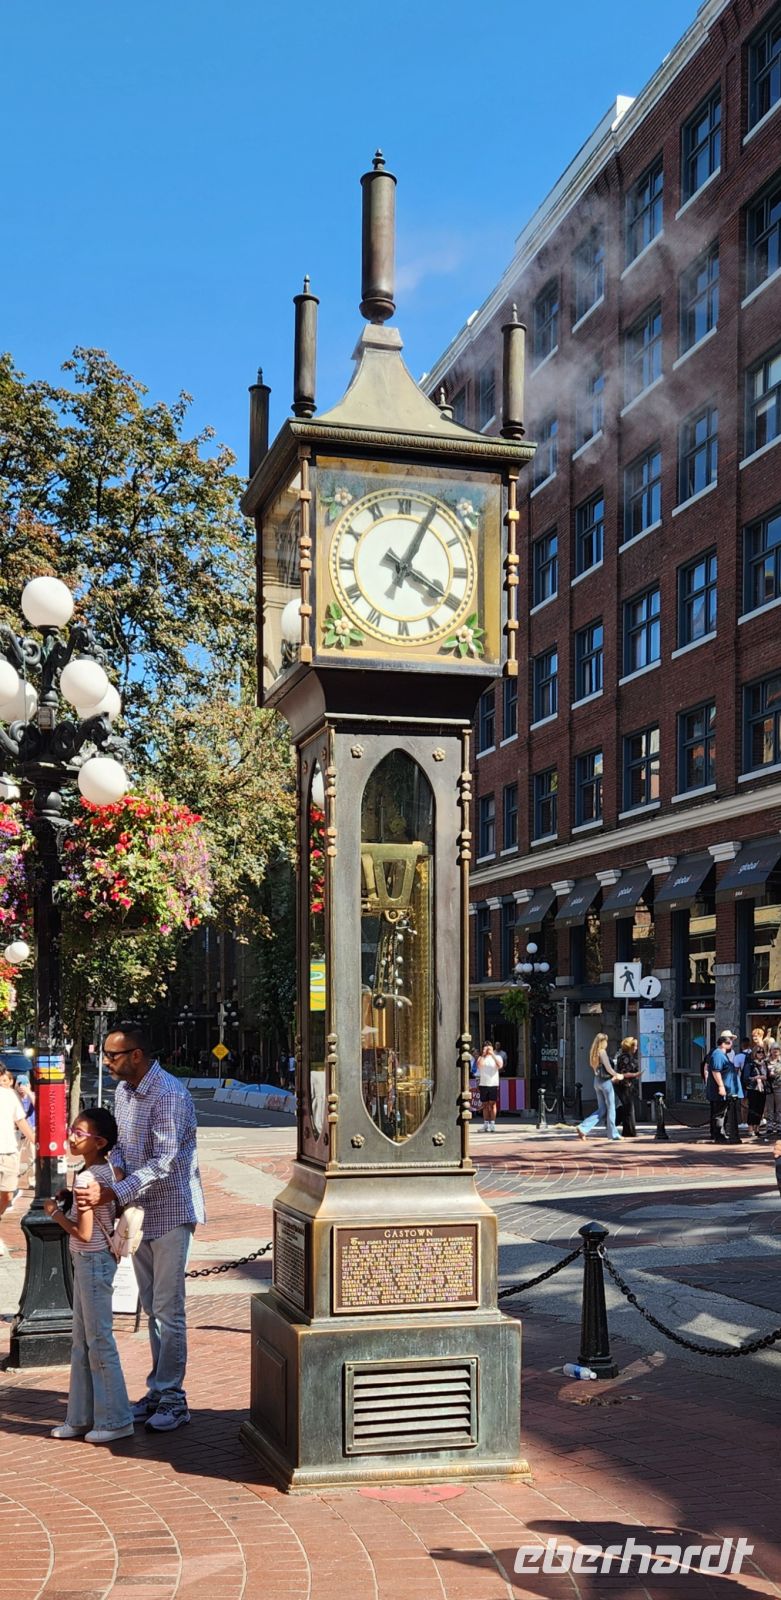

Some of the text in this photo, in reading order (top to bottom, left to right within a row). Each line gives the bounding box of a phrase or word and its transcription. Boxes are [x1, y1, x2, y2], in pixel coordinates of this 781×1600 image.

[367, 502, 383, 521] XI
[398, 499, 411, 515] XII
[345, 525, 362, 541] X
[384, 1229, 433, 1239] GASTOWN
